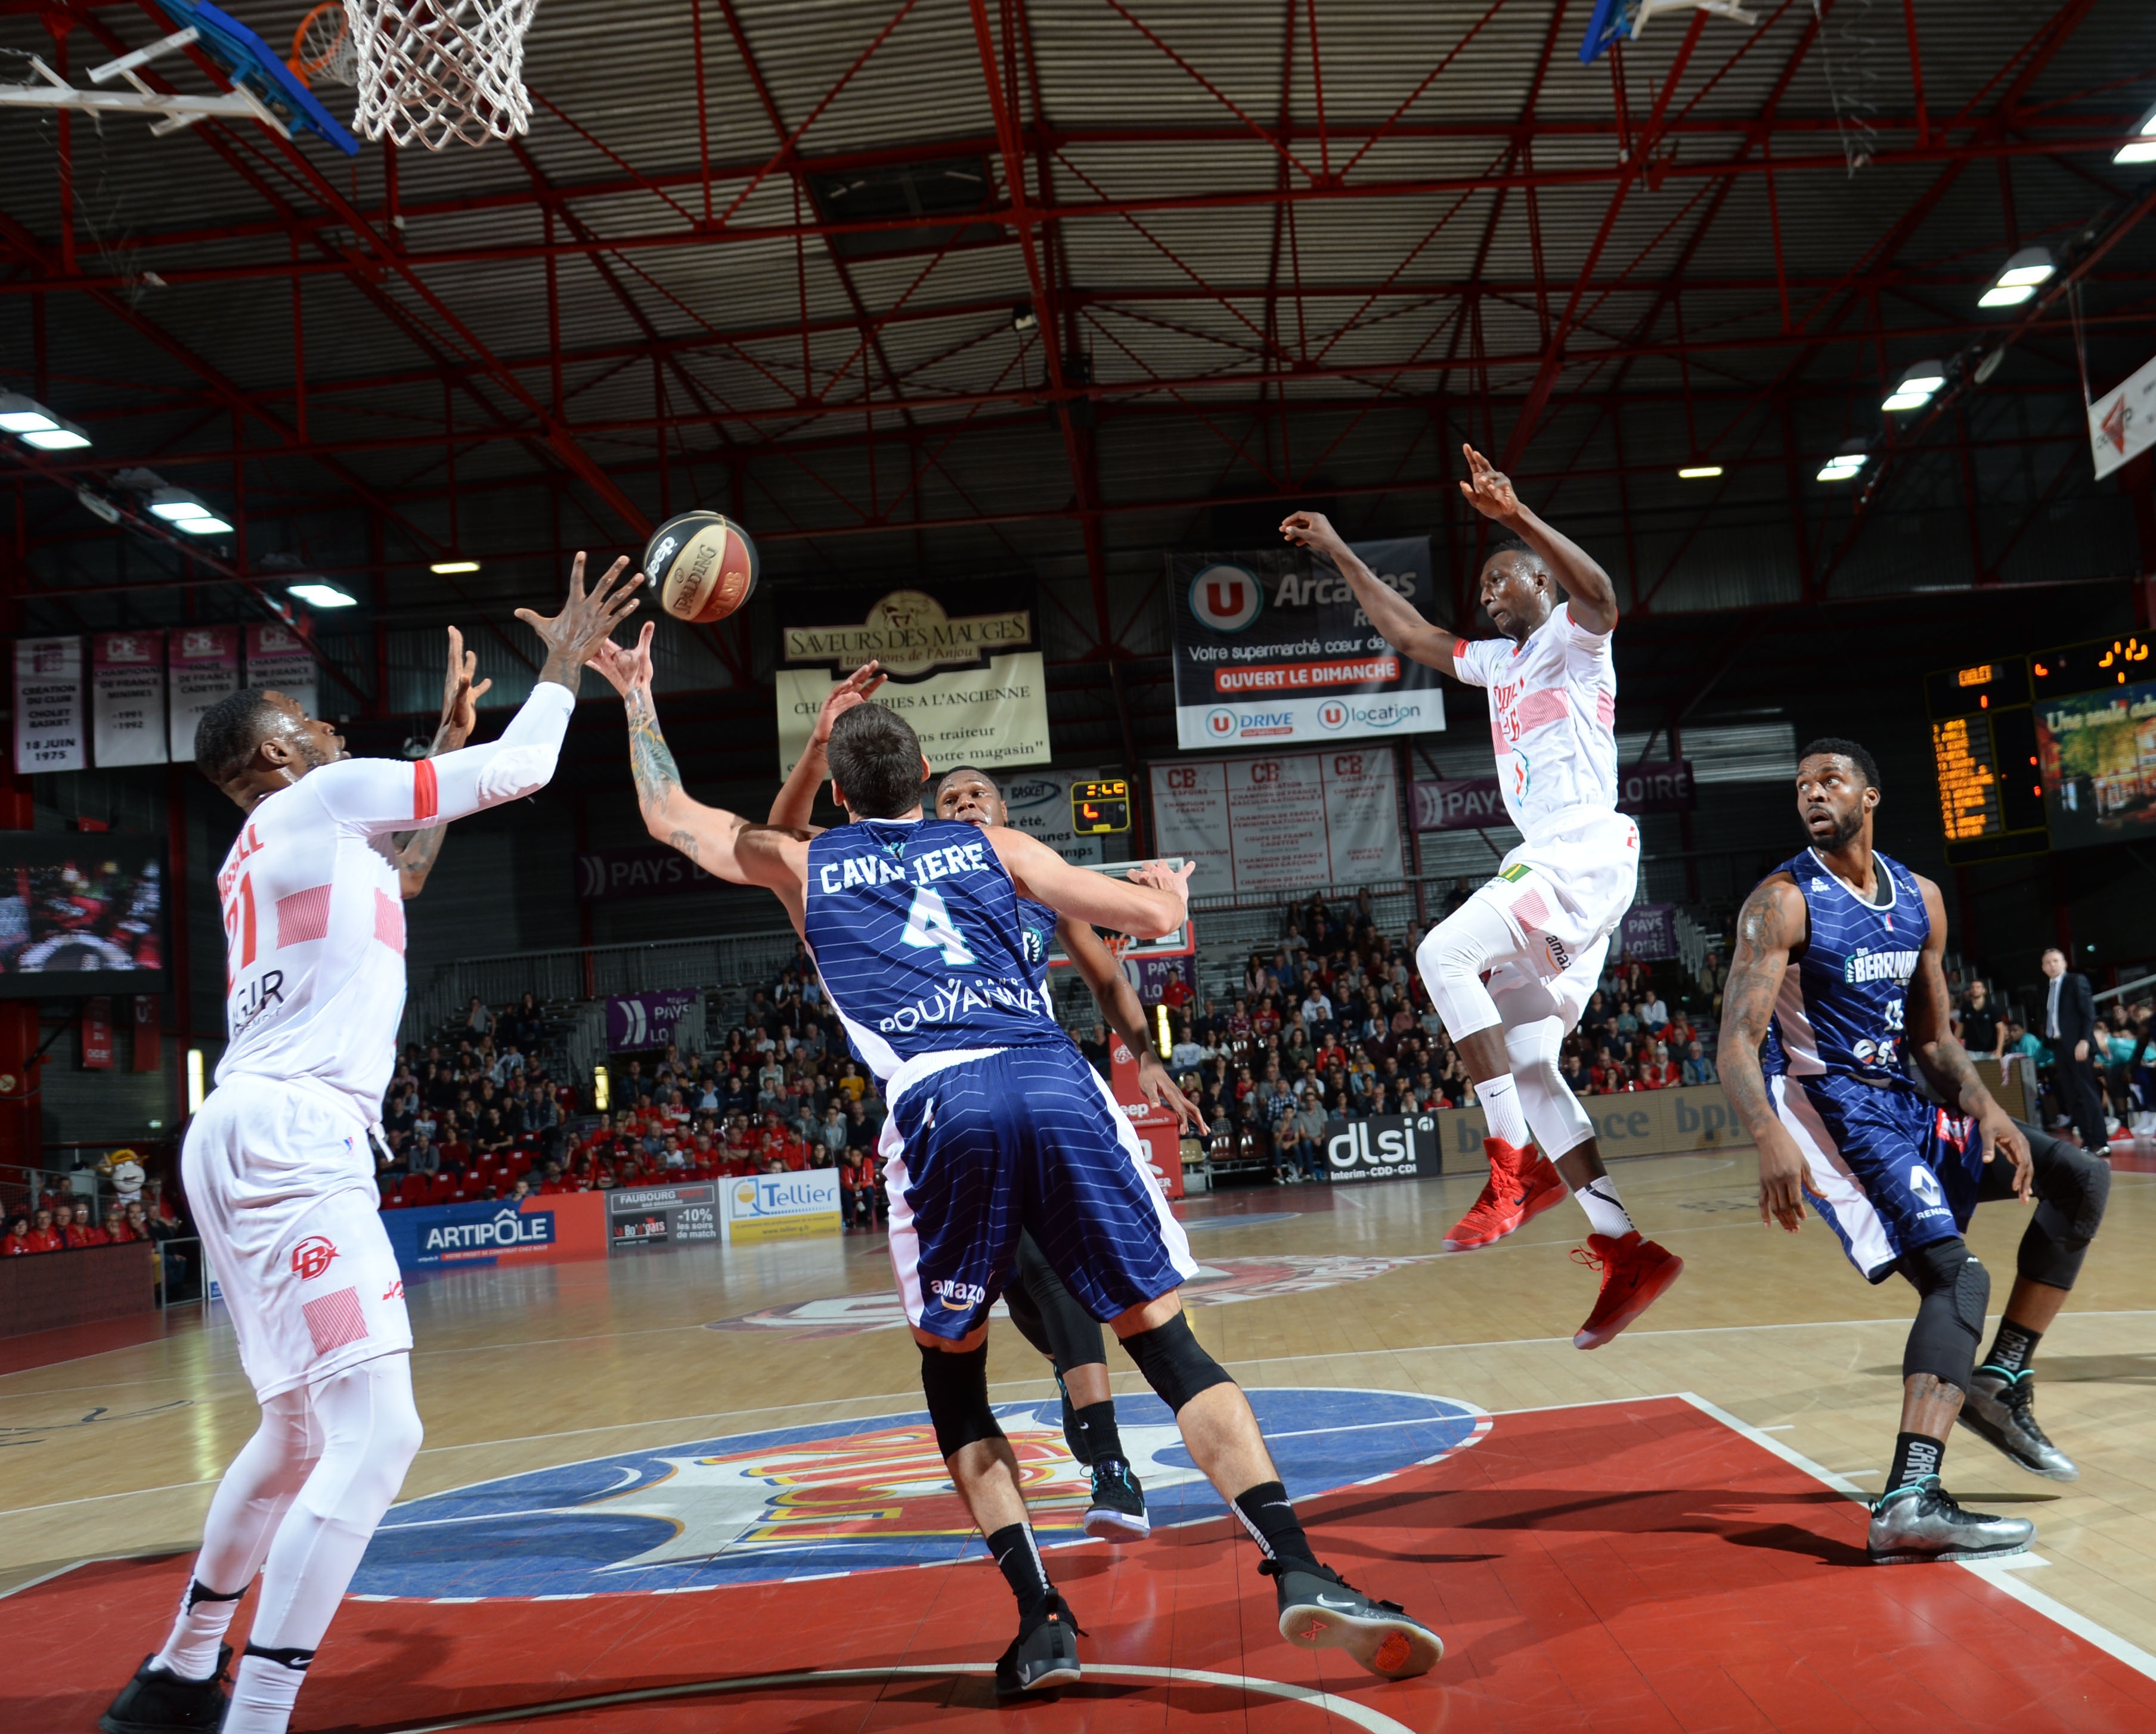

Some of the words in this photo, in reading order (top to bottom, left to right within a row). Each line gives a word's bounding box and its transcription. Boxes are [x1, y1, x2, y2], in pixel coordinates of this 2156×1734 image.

[673, 543, 717, 615] SPALDING
[1206, 582, 1244, 617] U
[1274, 567, 1417, 607] Arcaes
[789, 625, 884, 654] SAVEURS
[888, 625, 927, 649] DES
[933, 614, 1027, 646] MAUGES
[845, 650, 906, 668] traditions
[908, 649, 924, 662] de
[927, 645, 974, 662] l'Anjou
[1189, 644, 1228, 662] Votre
[1232, 637, 1320, 662] supermarché
[1367, 634, 1386, 650] de
[1219, 668, 1285, 689] OUVERT
[1289, 667, 1308, 684] LE
[1312, 662, 1396, 683] DIMANCHE
[933, 685, 1030, 706] L'ANCIENNE
[1240, 712, 1293, 728] DRIVE
[1352, 702, 1421, 722] location
[44, 739, 75, 749] JUIN
[939, 726, 996, 741] traiteur
[35, 750, 66, 761] 1975
[927, 746, 964, 762] votre
[1251, 762, 1280, 783] CB
[1334, 755, 1362, 776] CB
[1167, 768, 1197, 789] CB
[1618, 773, 1689, 803] OIRE
[1011, 786, 1045, 799] BASKET
[611, 857, 684, 887] PAYS
[900, 885, 979, 966] 4
[1628, 917, 1665, 933] PAYS
[1545, 935, 1571, 971] amaz
[1120, 1103, 1149, 1119] eep
[1328, 1117, 1416, 1167] dlsi
[620, 1190, 677, 1204] FAUBOURG
[761, 1183, 836, 1207] Tellier
[678, 1208, 713, 1221] -10%
[426, 1208, 548, 1251] ARTIPÔLE
[676, 1231, 688, 1239] de
[689, 1230, 717, 1238] match
[677, 1222, 690, 1230] les
[691, 1221, 714, 1230] soirs
[930, 1277, 986, 1304] amazo
